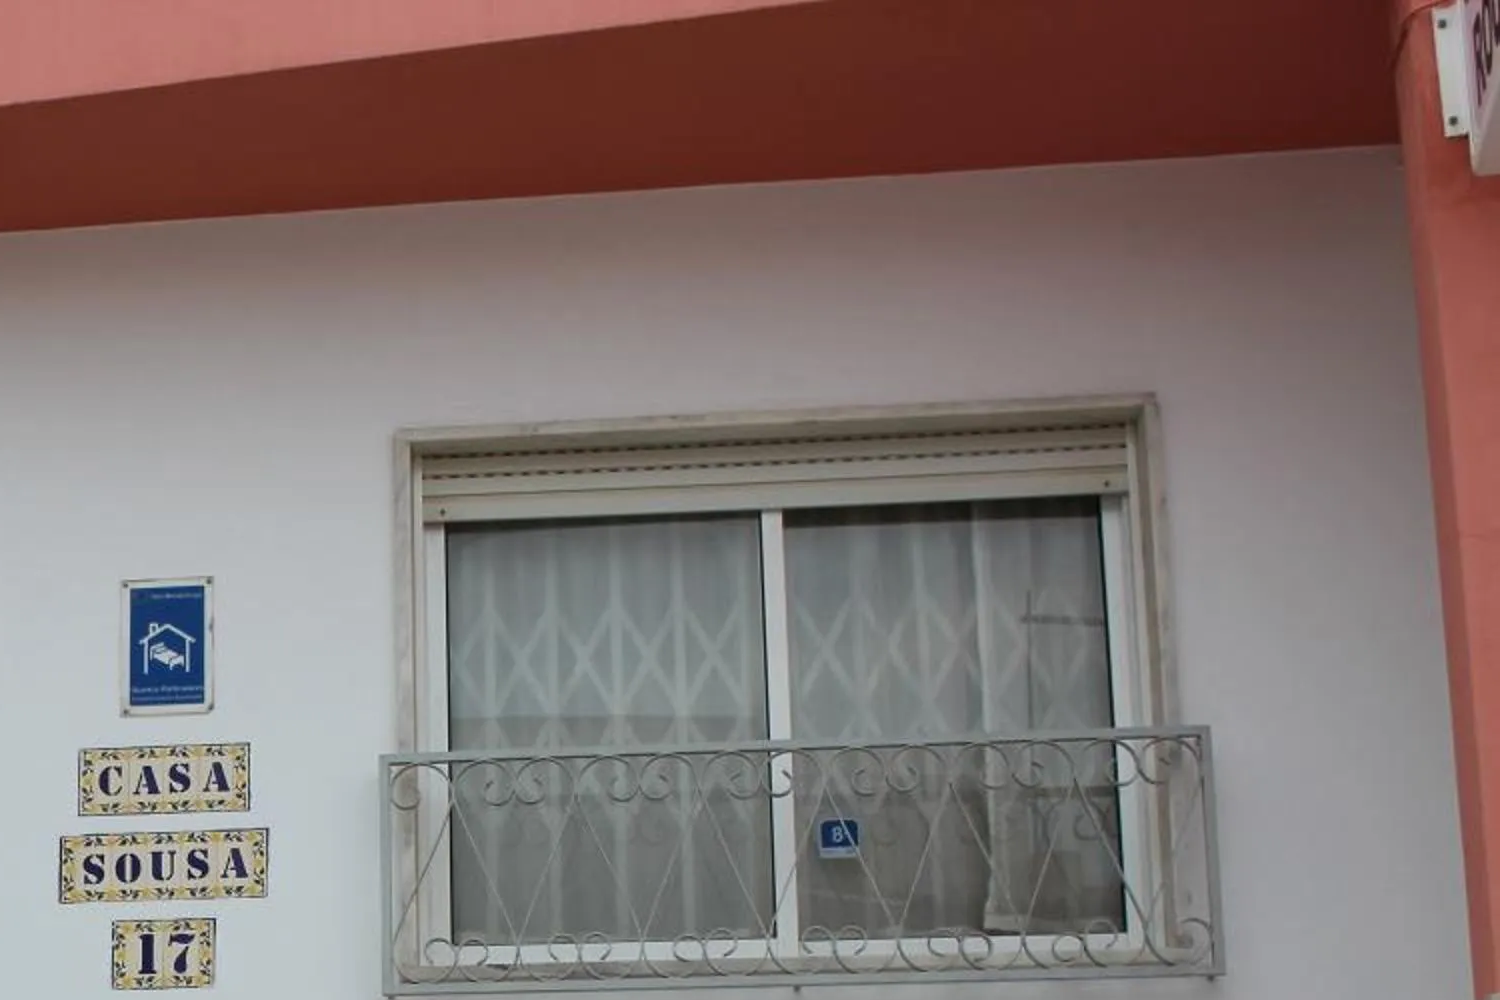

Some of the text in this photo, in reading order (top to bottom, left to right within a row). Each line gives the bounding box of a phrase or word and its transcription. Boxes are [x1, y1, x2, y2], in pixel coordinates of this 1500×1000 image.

[98, 761, 230, 796] CASA
[83, 848, 249, 885] SOUSA
[138, 933, 195, 974] 17
